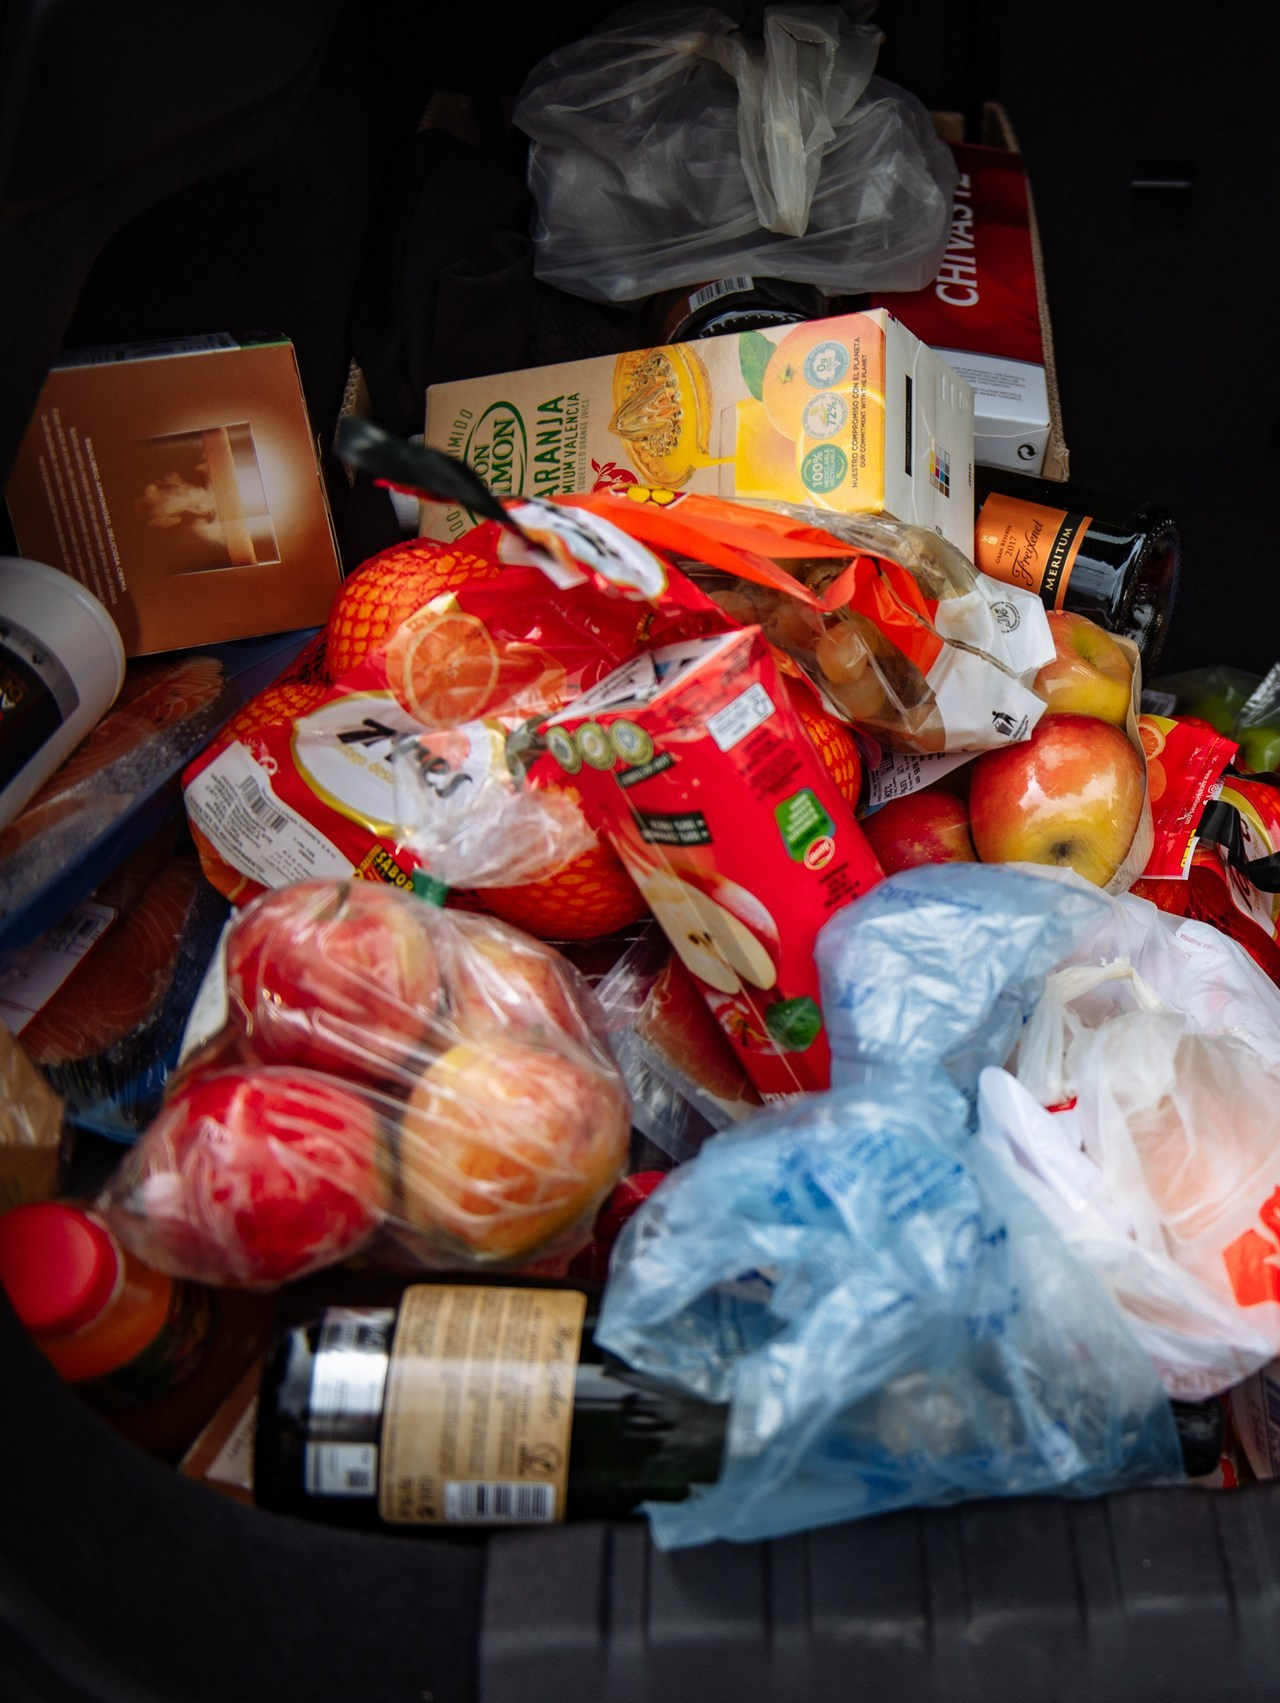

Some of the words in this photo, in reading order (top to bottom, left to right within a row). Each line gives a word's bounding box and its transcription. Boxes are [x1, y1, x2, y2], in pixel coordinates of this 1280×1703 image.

[853, 337, 861, 371] PLANETA
[853, 372, 859, 381] EL
[564, 392, 580, 458] VALENCIA
[581, 399, 590, 419] JUICE
[826, 401, 837, 427] 72%
[447, 408, 473, 458] IMIDO
[533, 395, 565, 497] ARANJA
[579, 420, 589, 451] ORANGE
[491, 418, 516, 494] IMON
[577, 452, 587, 490] SQUEEZED
[812, 450, 824, 488] 100%
[562, 460, 577, 494] MIUM
[84, 437, 101, 481] EQUILIBRIO
[96, 480, 113, 527] ARMONIOSO,
[106, 527, 121, 566] DELICIOSA
[116, 566, 128, 592] CREMA
[1005, 536, 1017, 556] 2017
[1012, 519, 1043, 586] Freixenet
[1045, 528, 1073, 590] MERITUM
